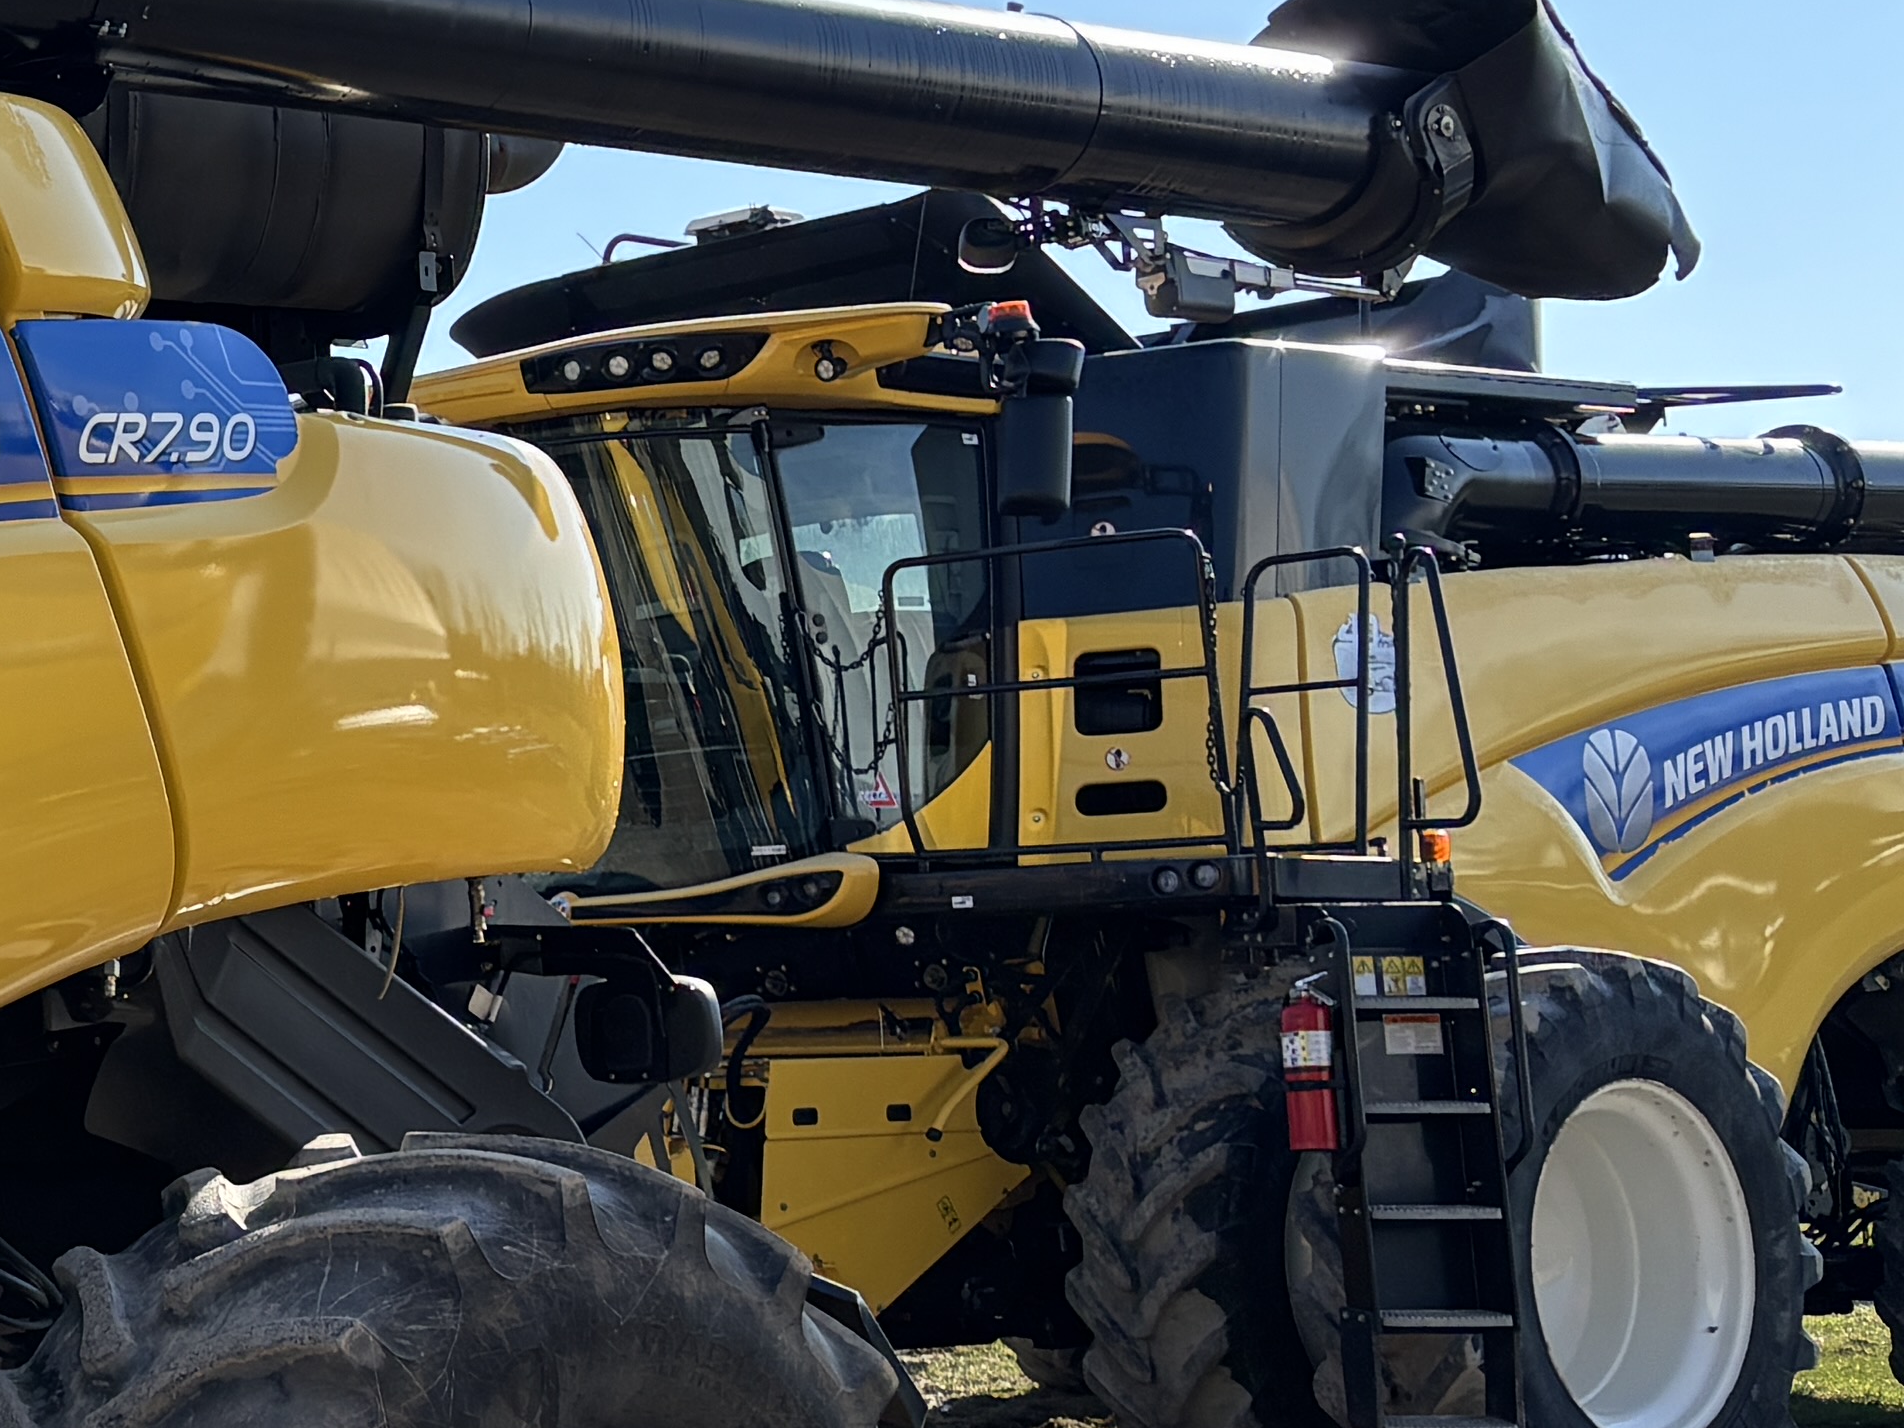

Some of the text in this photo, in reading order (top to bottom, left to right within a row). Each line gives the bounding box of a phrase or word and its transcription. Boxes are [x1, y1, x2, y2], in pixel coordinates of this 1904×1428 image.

[77, 411, 258, 465] CR7.90
[1662, 694, 1887, 810] NEW HOLLAND
